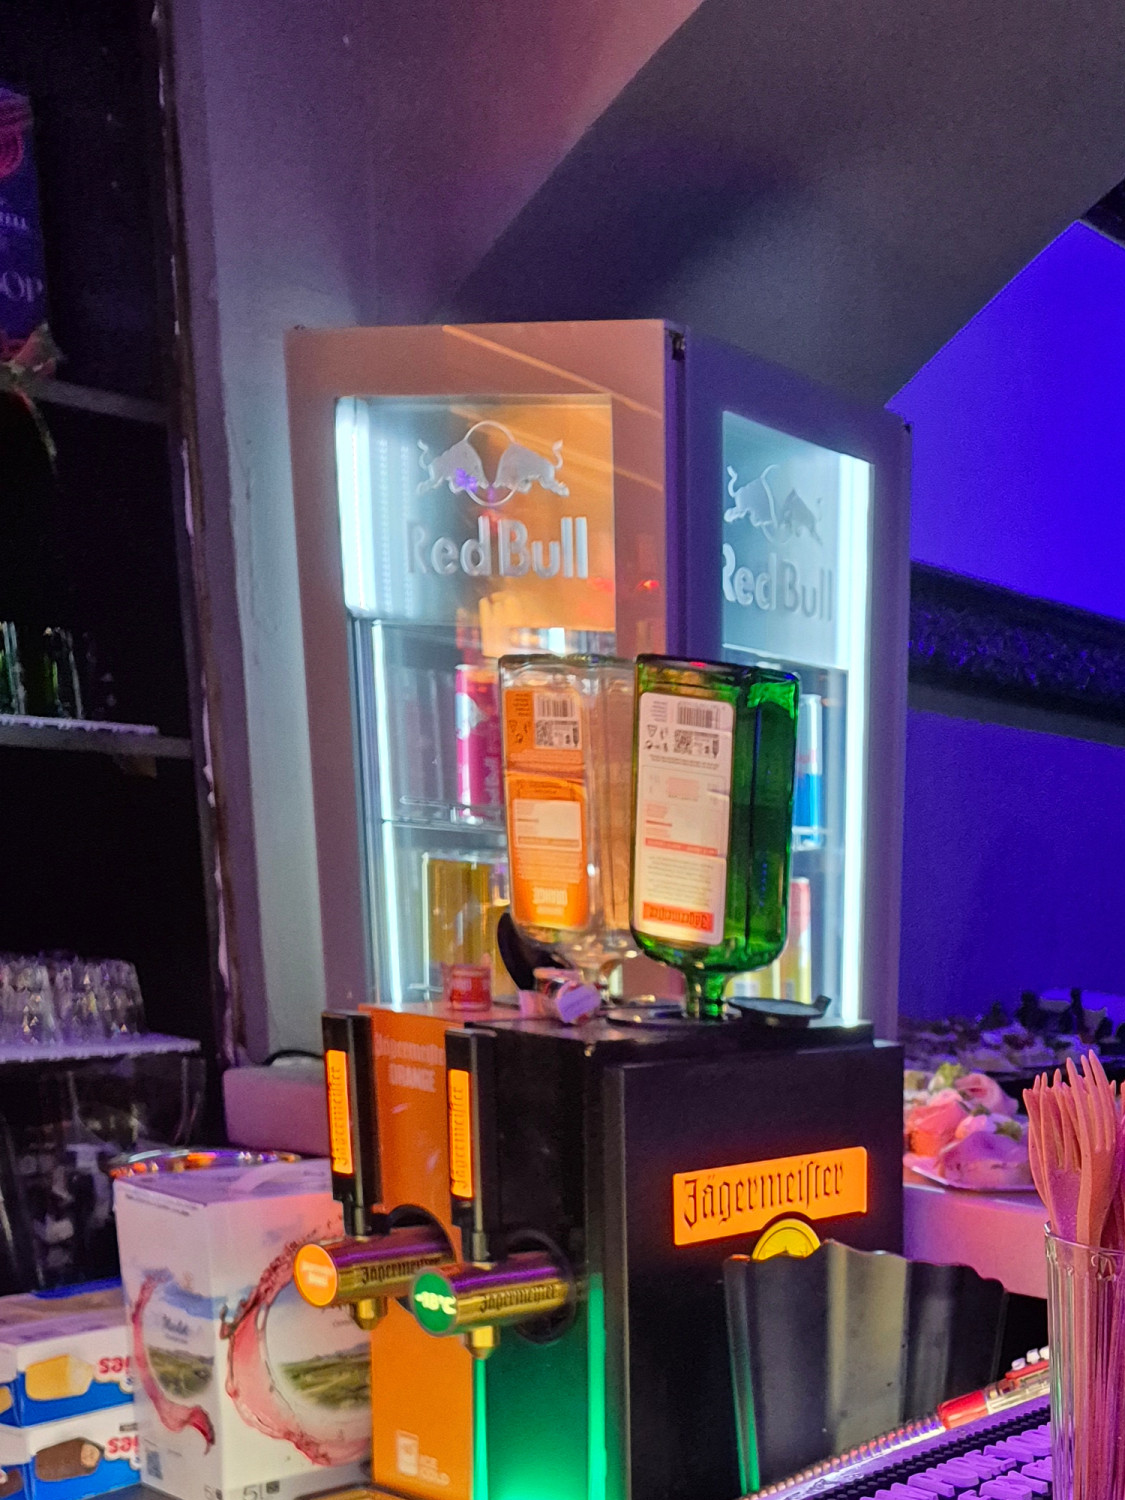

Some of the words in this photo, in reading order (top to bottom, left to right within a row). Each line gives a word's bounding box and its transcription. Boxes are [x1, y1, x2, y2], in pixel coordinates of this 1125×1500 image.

[407, 515, 491, 577] Red
[499, 515, 589, 579] Bull
[722, 541, 776, 612] Red
[781, 556, 834, 622] Bull
[683, 1161, 844, 1230] Jägermeister
